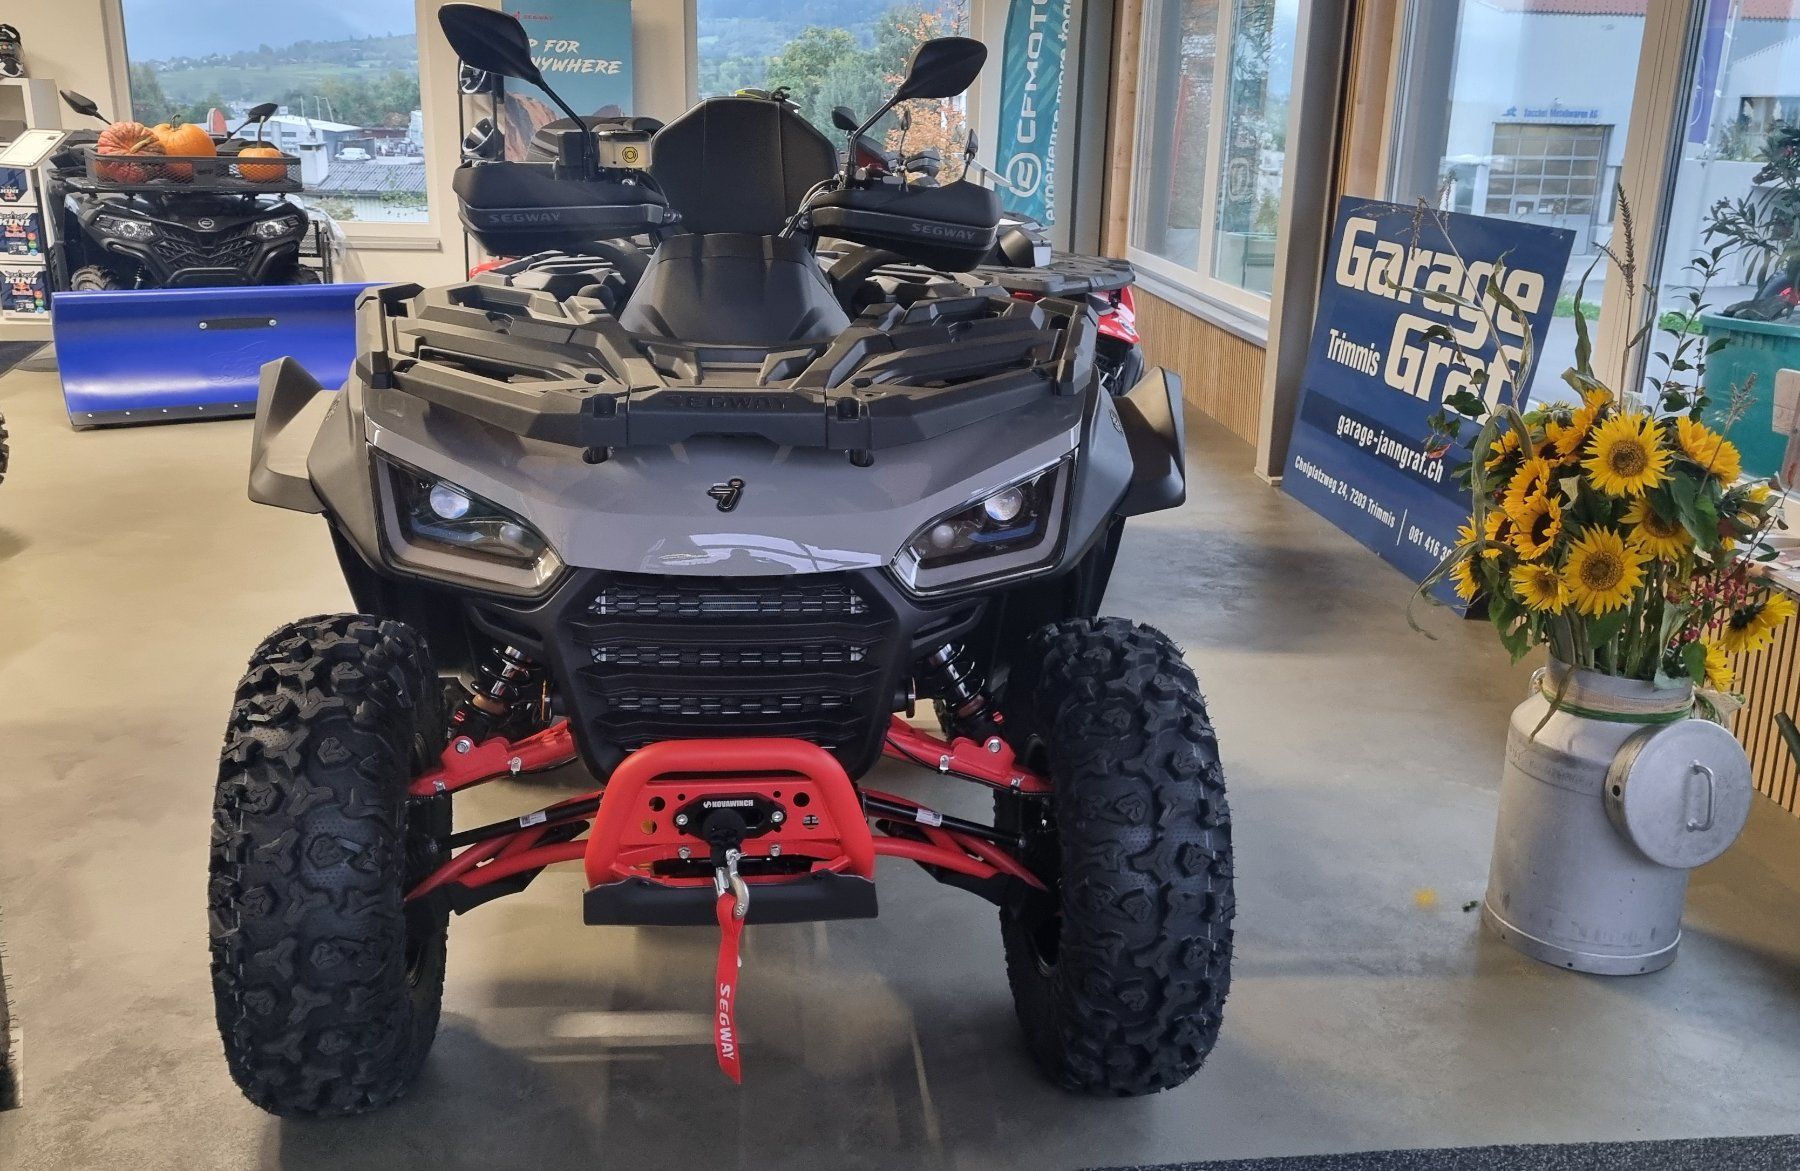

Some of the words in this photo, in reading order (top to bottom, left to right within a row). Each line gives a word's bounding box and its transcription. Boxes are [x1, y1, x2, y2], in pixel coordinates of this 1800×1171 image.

[530, 56, 623, 75] NYWHERE
[543, 39, 580, 54] FOR
[1016, 0, 1048, 144] CFMOT
[488, 212, 560, 223] SEGWAY
[911, 222, 976, 240] SEGWAY
[5, 276, 38, 285] KINI
[1335, 216, 1545, 350] Garage
[1326, 328, 1381, 378] Trimmis
[1384, 312, 1526, 427] Graf
[1336, 414, 1445, 484] garage-janngraf.ch
[1294, 455, 1338, 494] Cholplatzweg
[1337, 480, 1349, 501] 24,
[1349, 487, 1368, 510] 7203
[1367, 498, 1397, 528] Trimmis
[1408, 525, 1424, 546] 081
[1424, 535, 1441, 557] 416
[719, 982, 735, 1060] SEGWAY
